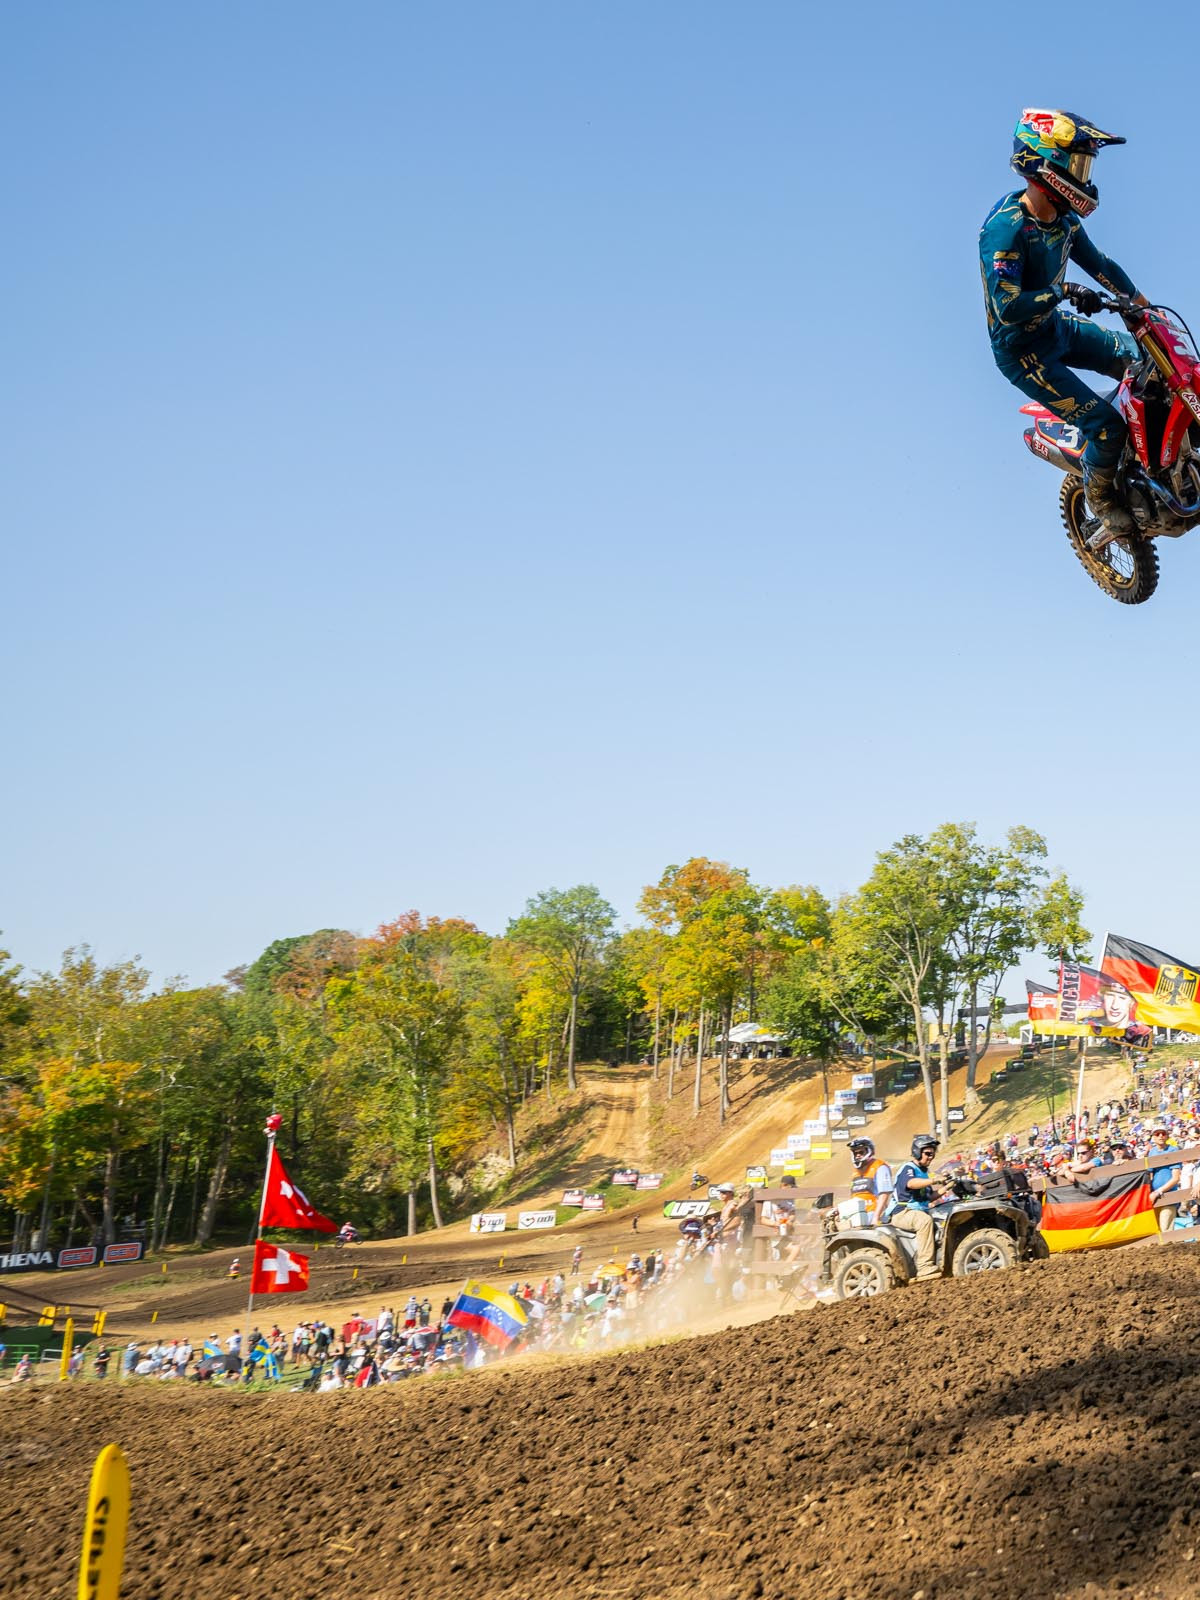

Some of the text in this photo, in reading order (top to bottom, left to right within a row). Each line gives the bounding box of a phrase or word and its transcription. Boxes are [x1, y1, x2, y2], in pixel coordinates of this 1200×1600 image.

[1056, 424, 1080, 448] 3
[670, 1201, 711, 1217] UFO
[0, 1251, 53, 1268] THENA
